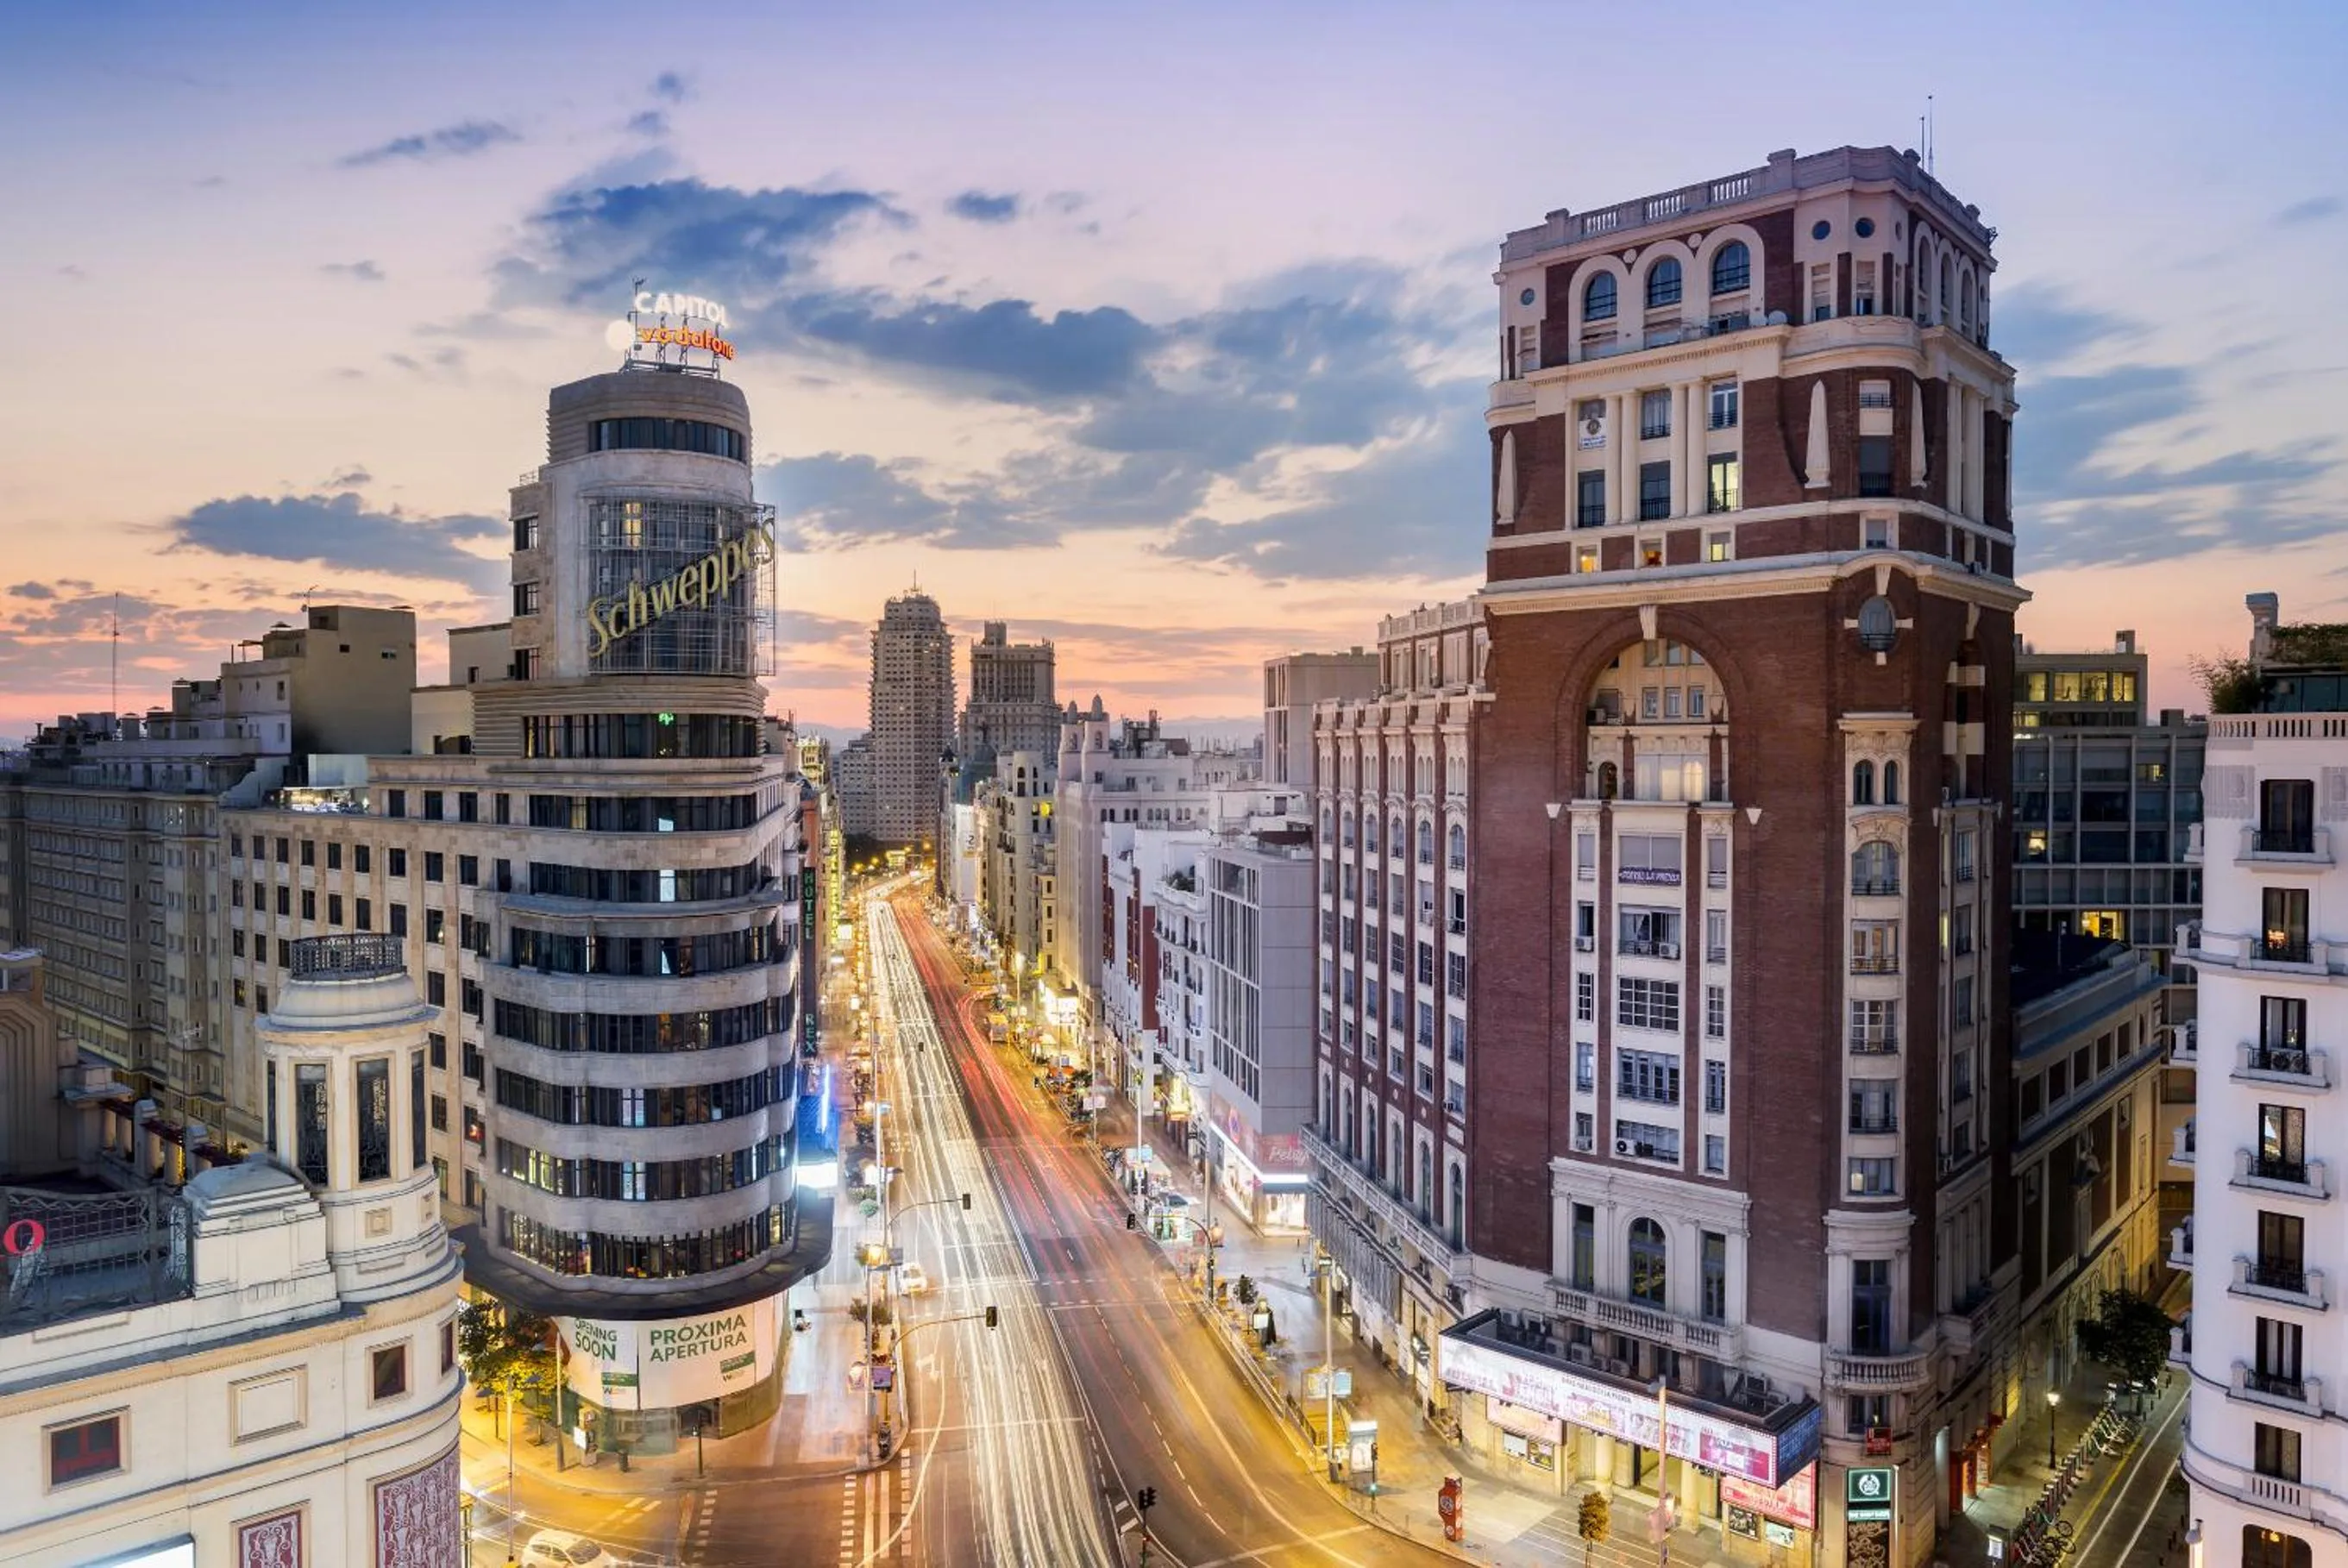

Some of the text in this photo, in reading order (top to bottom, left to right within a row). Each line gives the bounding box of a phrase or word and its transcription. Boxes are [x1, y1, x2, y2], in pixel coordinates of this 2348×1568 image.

[635, 292, 729, 328] CAPITOL
[640, 325, 735, 361] vodafone
[587, 517, 776, 660] Schweppes
[803, 873, 817, 1053] HOTEL REX
[574, 1317, 618, 1342] OPENING
[574, 1331, 616, 1361] SOON
[650, 1314, 747, 1345] PRÓXIMA
[650, 1331, 748, 1363] APERTURA
